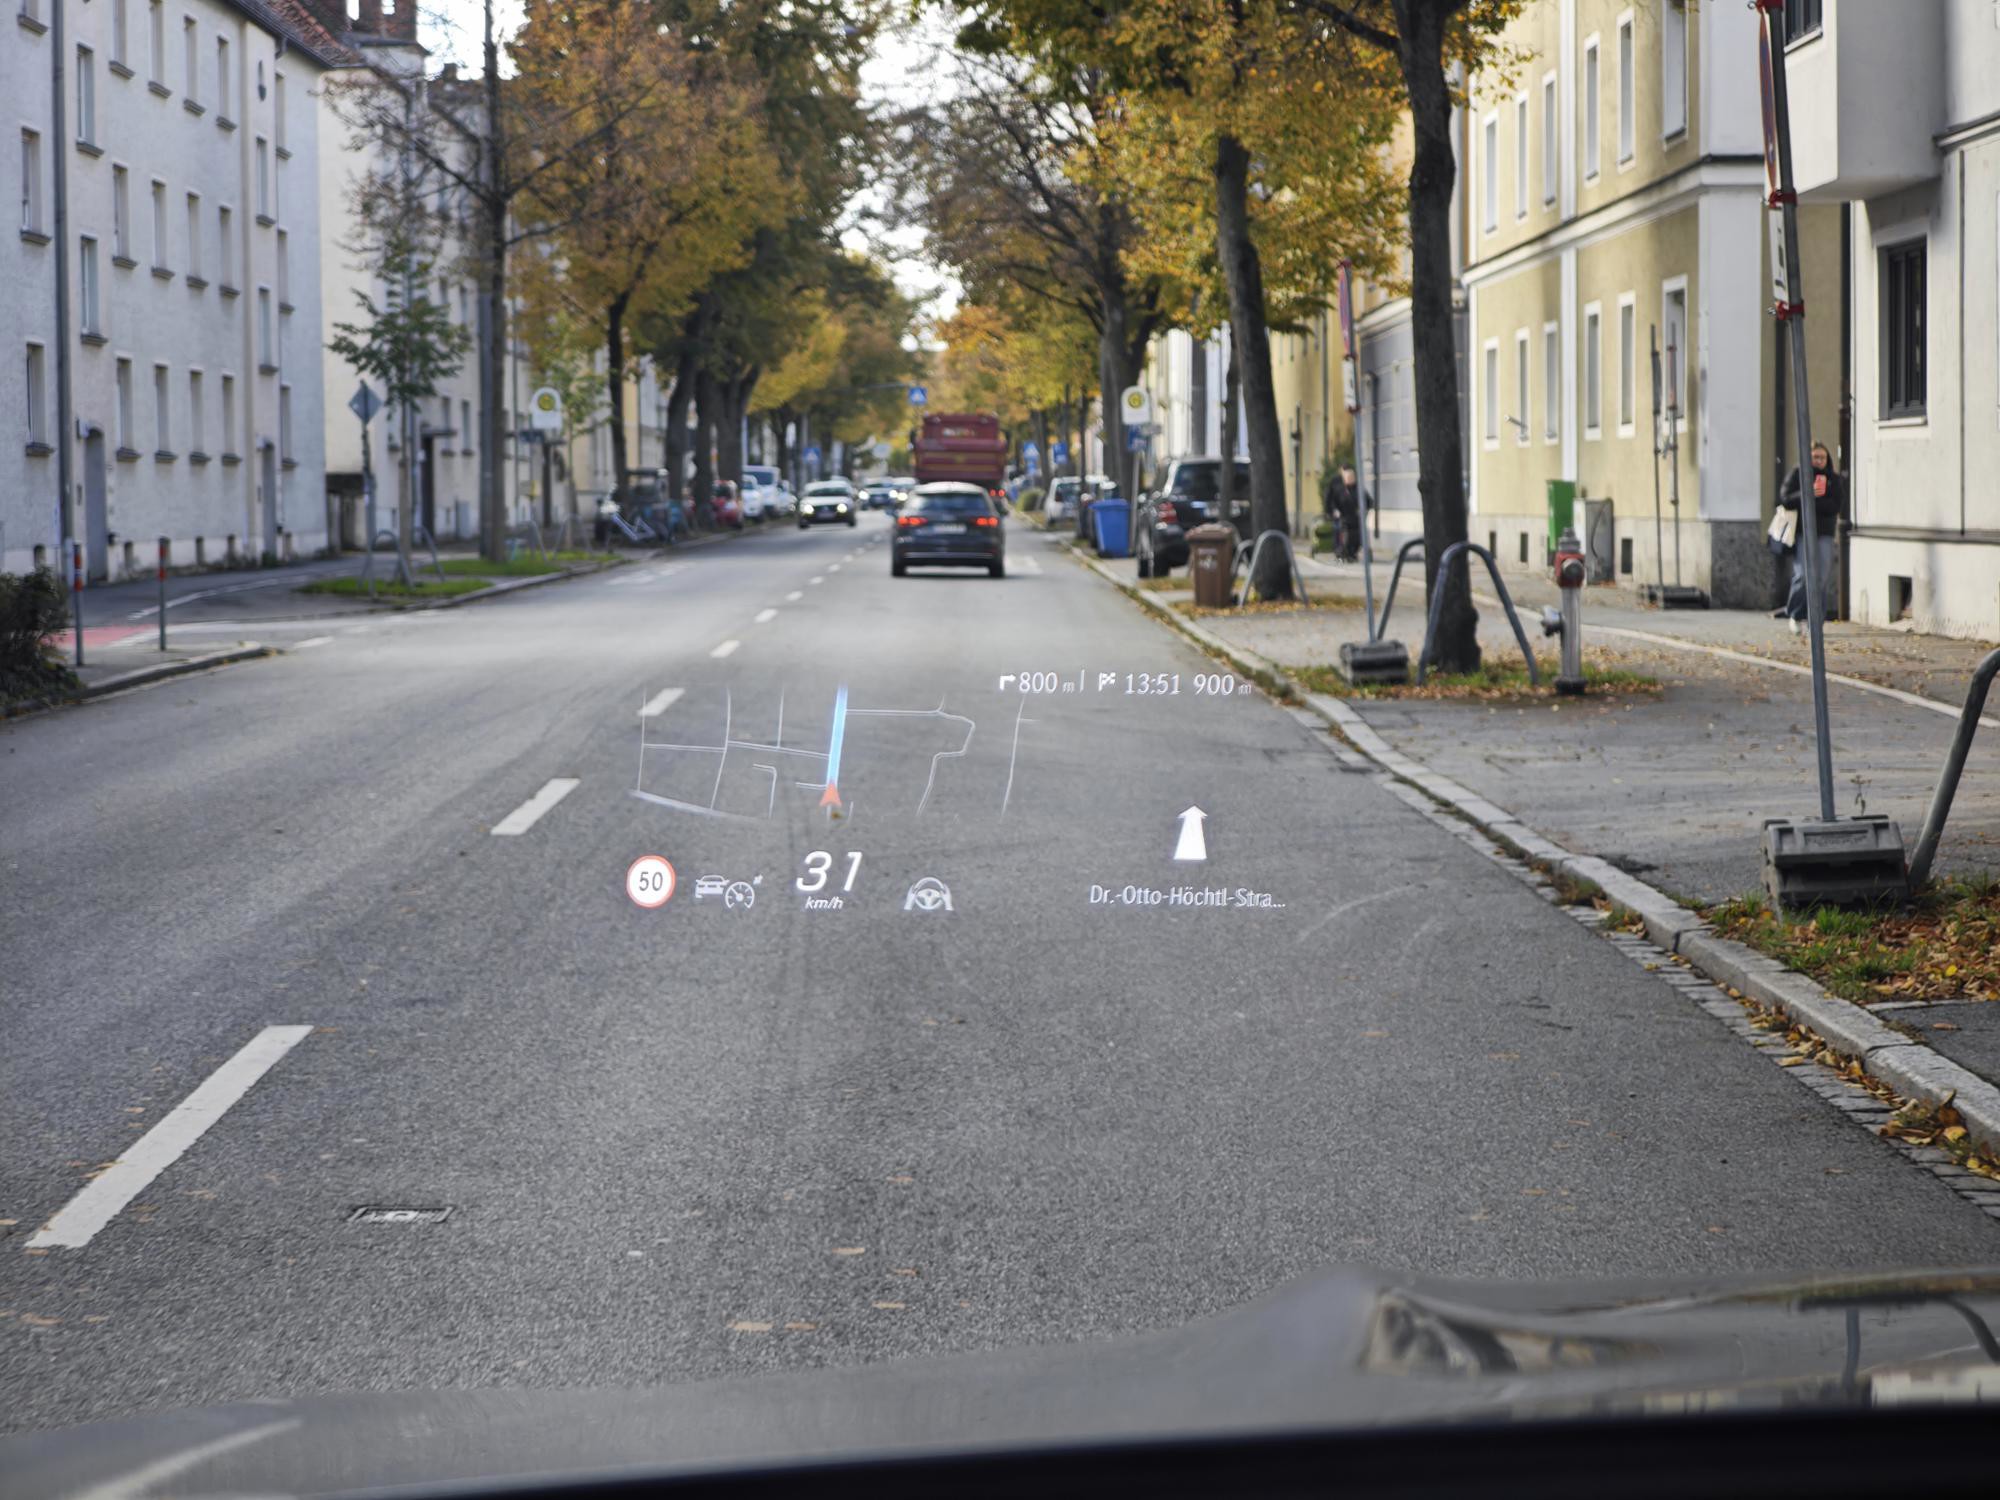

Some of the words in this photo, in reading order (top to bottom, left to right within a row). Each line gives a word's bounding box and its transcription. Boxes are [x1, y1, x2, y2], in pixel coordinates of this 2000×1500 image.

[1018, 671, 1058, 693] 800
[1124, 673, 1181, 695] 13:51
[1193, 674, 1235, 696] 900
[638, 870, 664, 891] 50
[796, 850, 863, 892] 31
[805, 896, 844, 909] km/h
